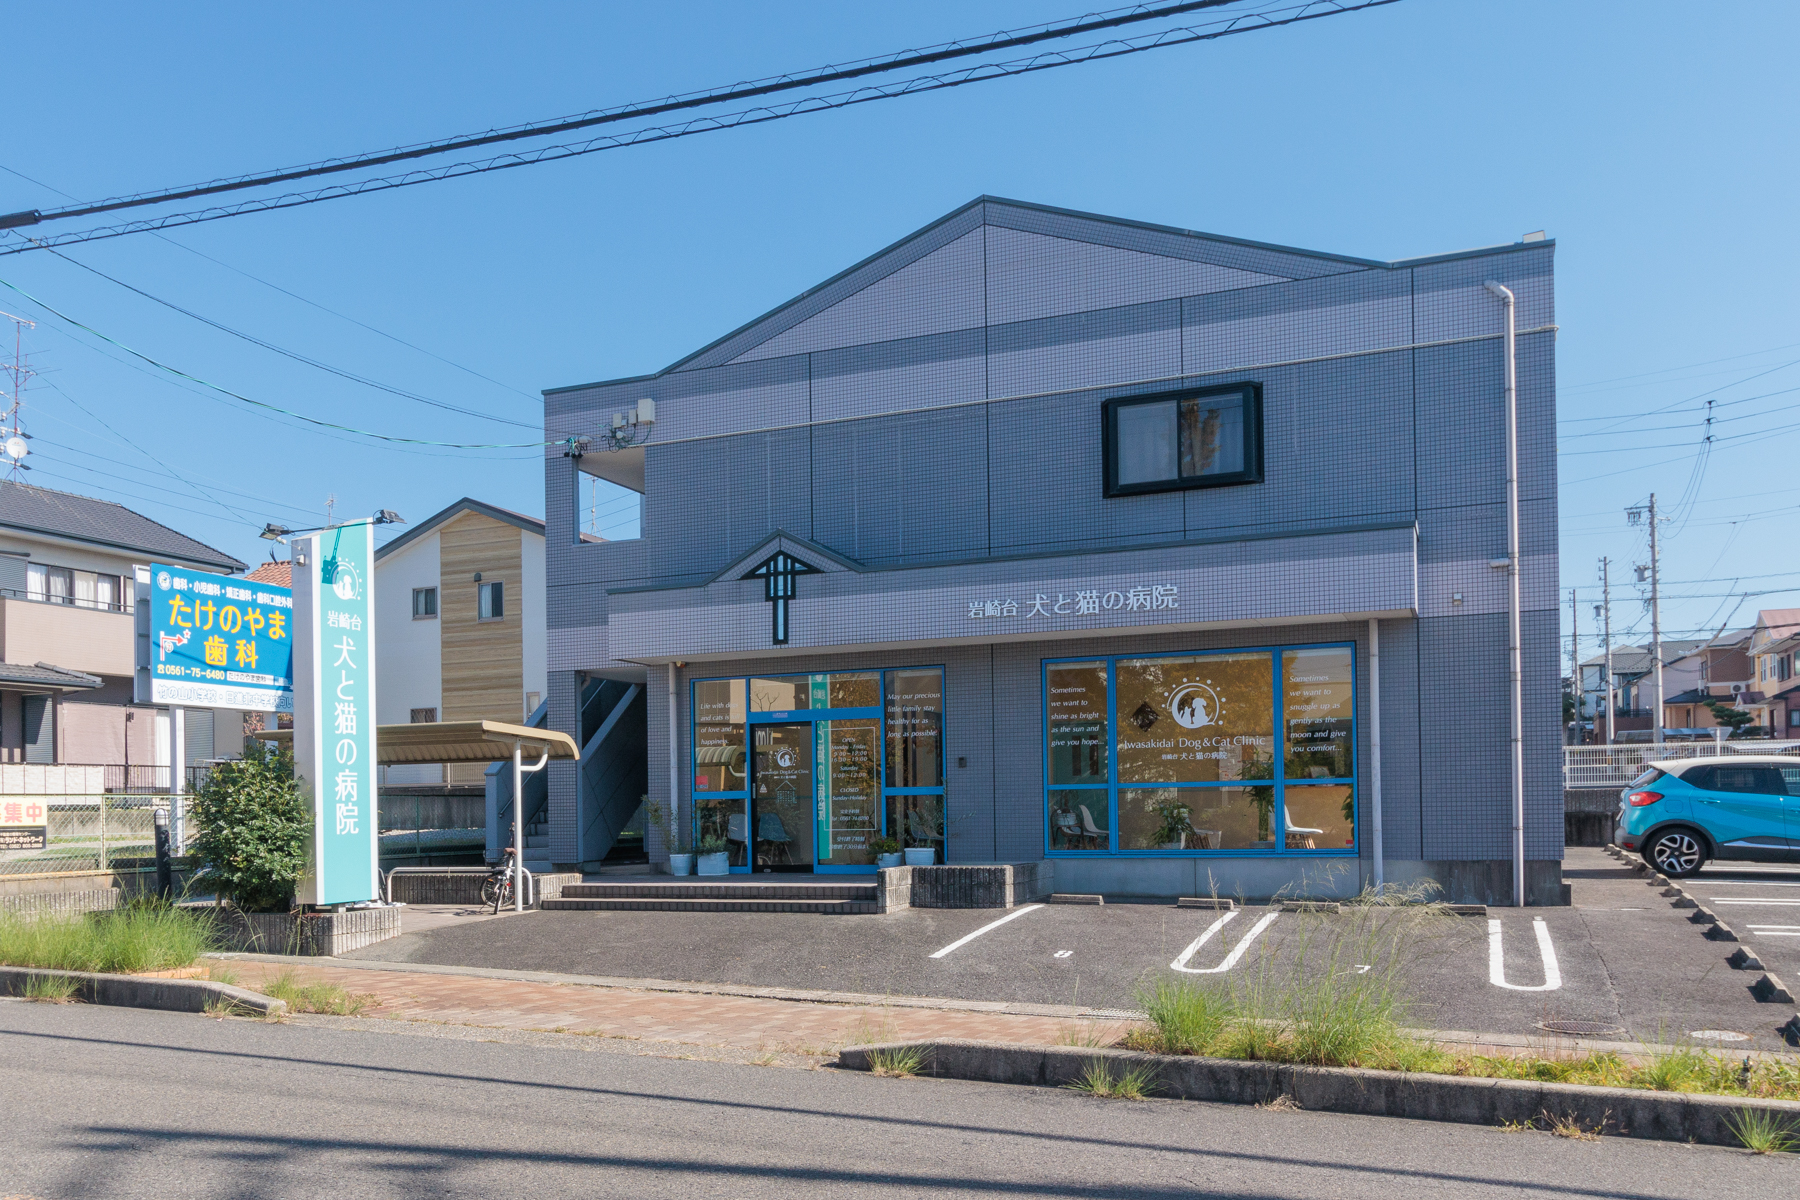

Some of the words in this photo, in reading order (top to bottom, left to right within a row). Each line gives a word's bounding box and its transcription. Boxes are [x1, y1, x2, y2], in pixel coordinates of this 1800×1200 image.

[968, 599, 1019, 619] 岩崎台
[1026, 584, 1179, 618] 犬と猫の病院
[168, 594, 286, 640] たけのやま
[327, 610, 362, 632] 岩崎台
[165, 664, 225, 680] 0561-75-6480
[1289, 675, 1329, 683] Sometimes
[914, 692, 940, 700] precious
[902, 705, 922, 713] family
[1290, 703, 1317, 712] snuggle
[1080, 712, 1099, 721] bright
[888, 718, 910, 726] healthy
[1290, 717, 1312, 726] gently
[333, 635, 359, 835] 犬と猫の病院
[1330, 730, 1346, 739] give
[1051, 739, 1066, 748] give
[1124, 738, 1174, 749] Iwasakidai
[1233, 735, 1266, 746] Clinic
[1290, 746, 1305, 754] you
[1179, 751, 1228, 761] 犬と猫の病院
[0, 802, 42, 823] 集中
[1355, 965, 1371, 973] 7
